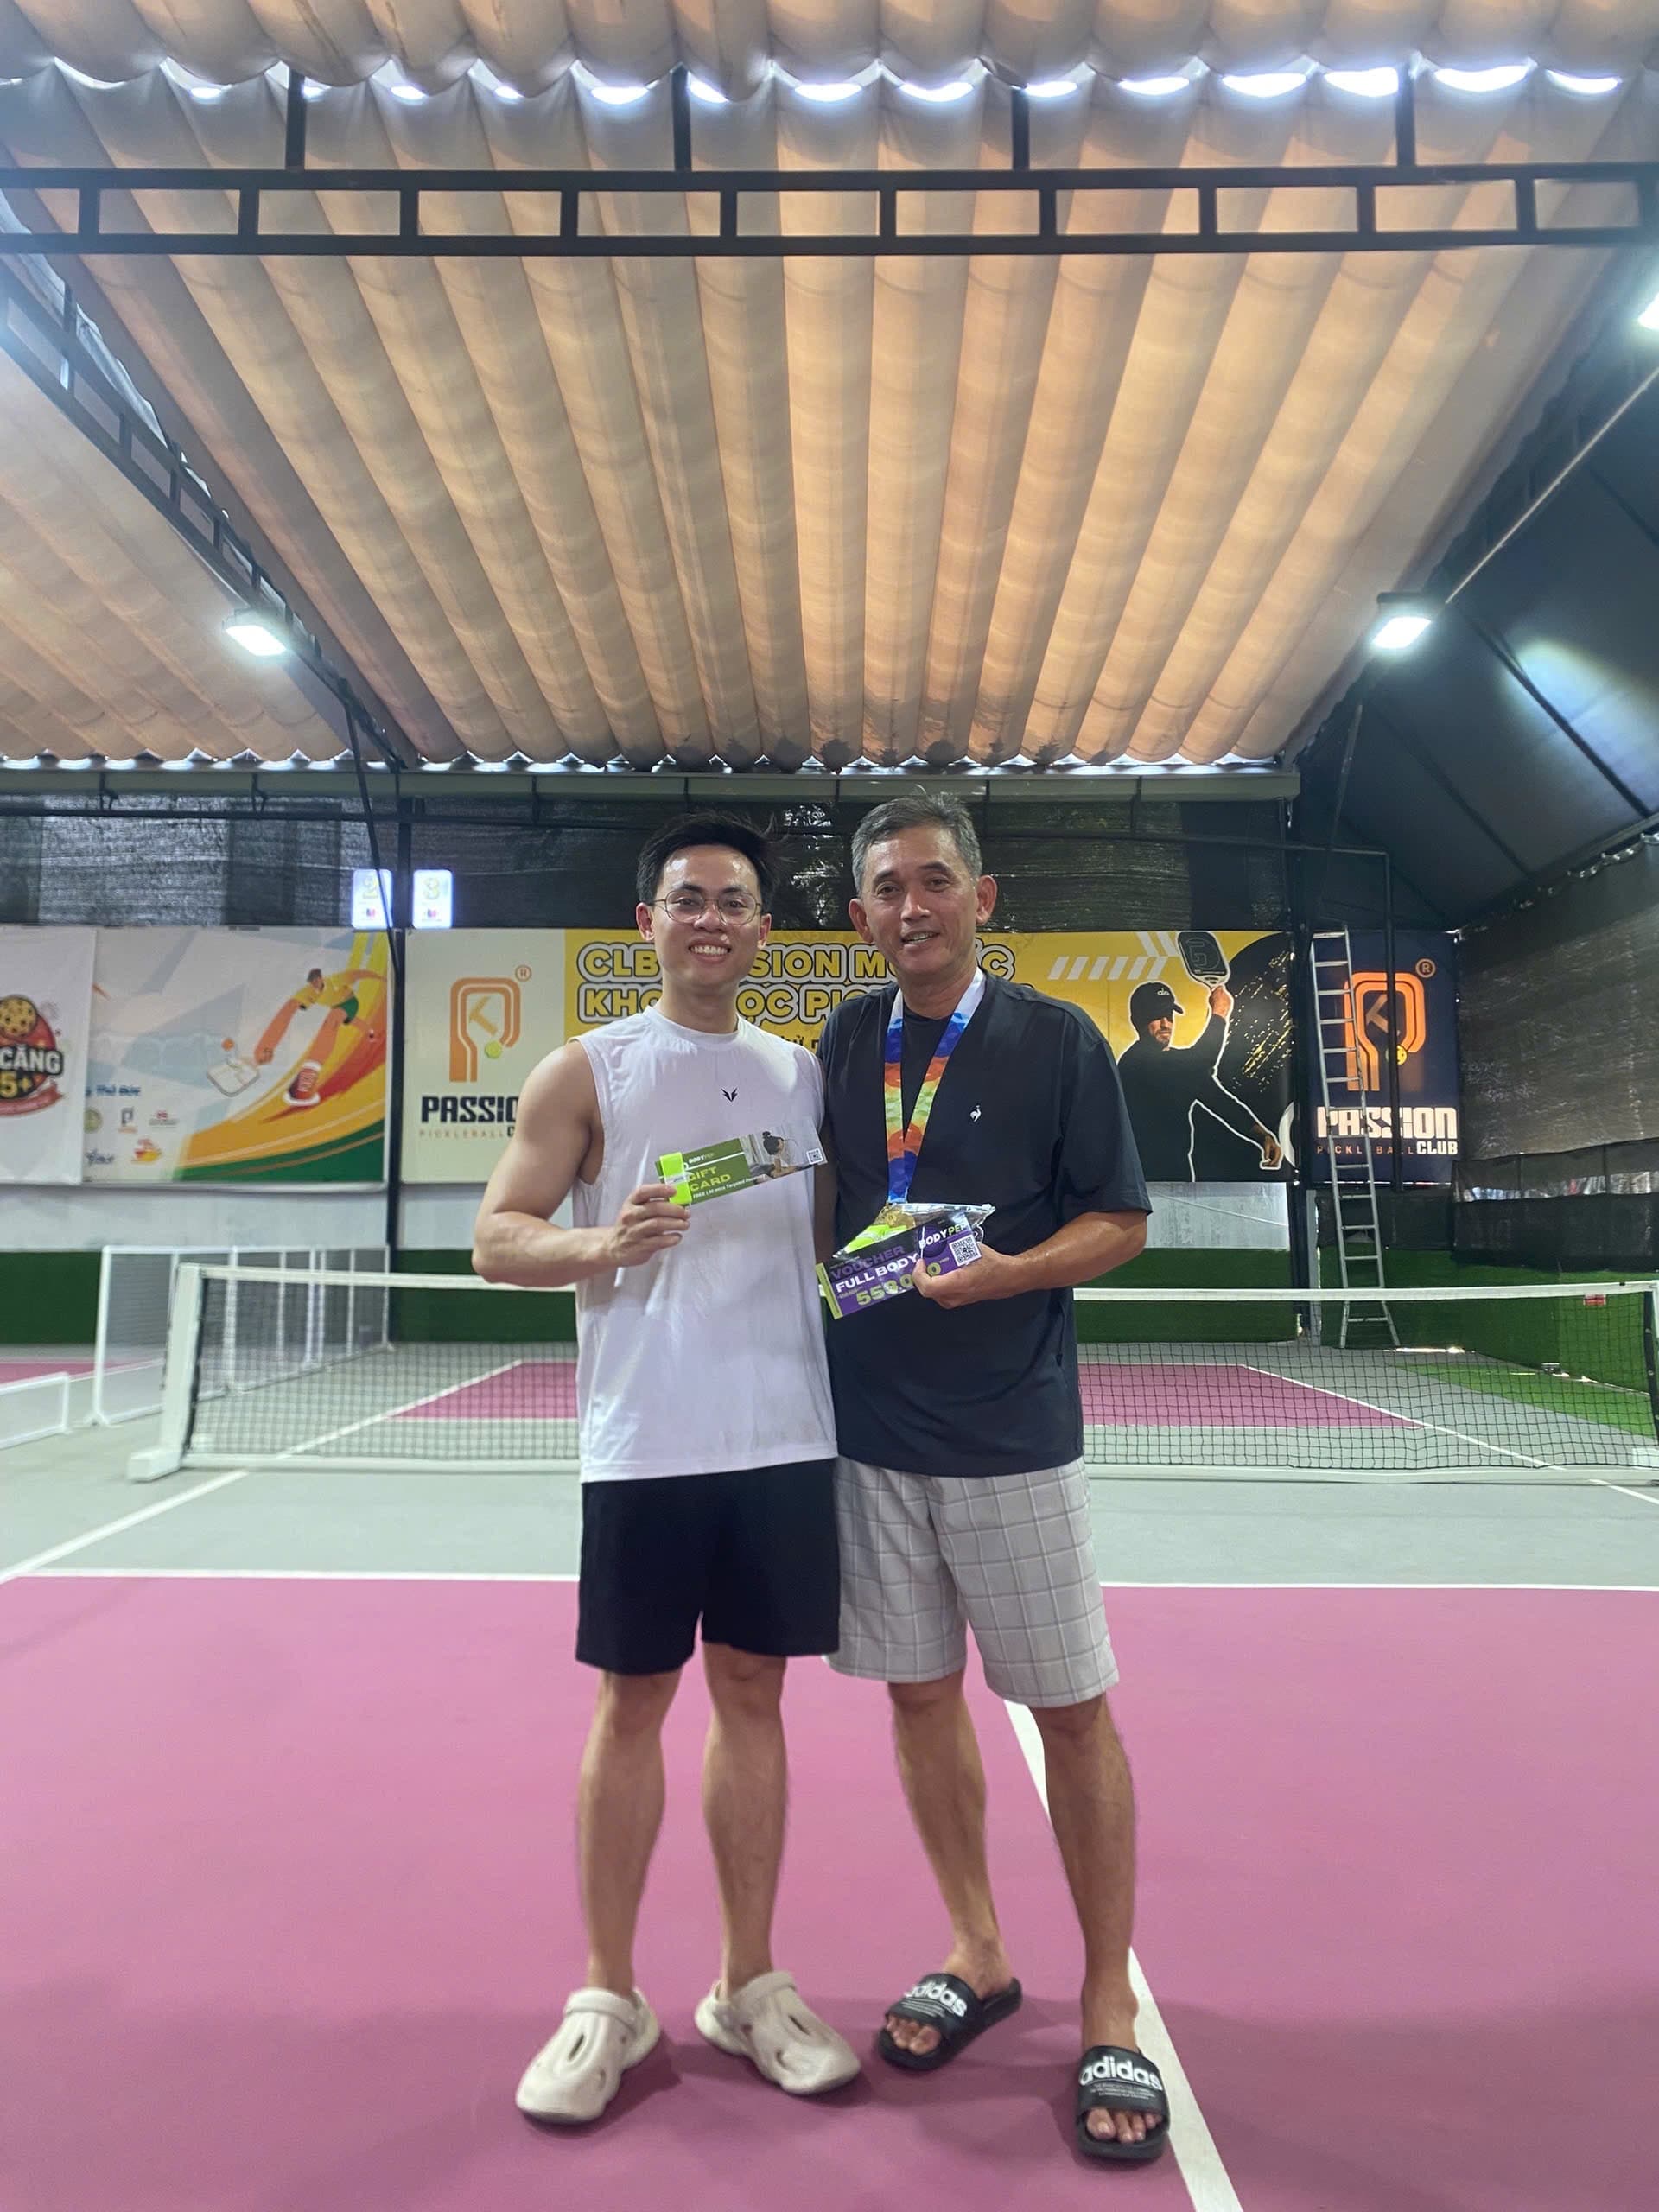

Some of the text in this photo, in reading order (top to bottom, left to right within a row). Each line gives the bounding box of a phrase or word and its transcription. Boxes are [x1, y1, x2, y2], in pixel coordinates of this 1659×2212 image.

[582, 949, 660, 978] CLB
[747, 950, 842, 980] SION
[735, 988, 795, 1024] ỌC
[421, 1096, 520, 1123] PASSIO
[1317, 1106, 1458, 1140] PASSION
[1317, 1141, 1458, 1155] PCKLBAL CLUB
[687, 1166, 717, 1183] GIFT
[690, 1173, 731, 1192] CARD
[830, 1245, 906, 1280] VOUCHER
[836, 1273, 875, 1294] FULL
[874, 1252, 918, 1278] BODY
[856, 1262, 942, 1306] 55.00
[1079, 2056, 1163, 2091] adidas
